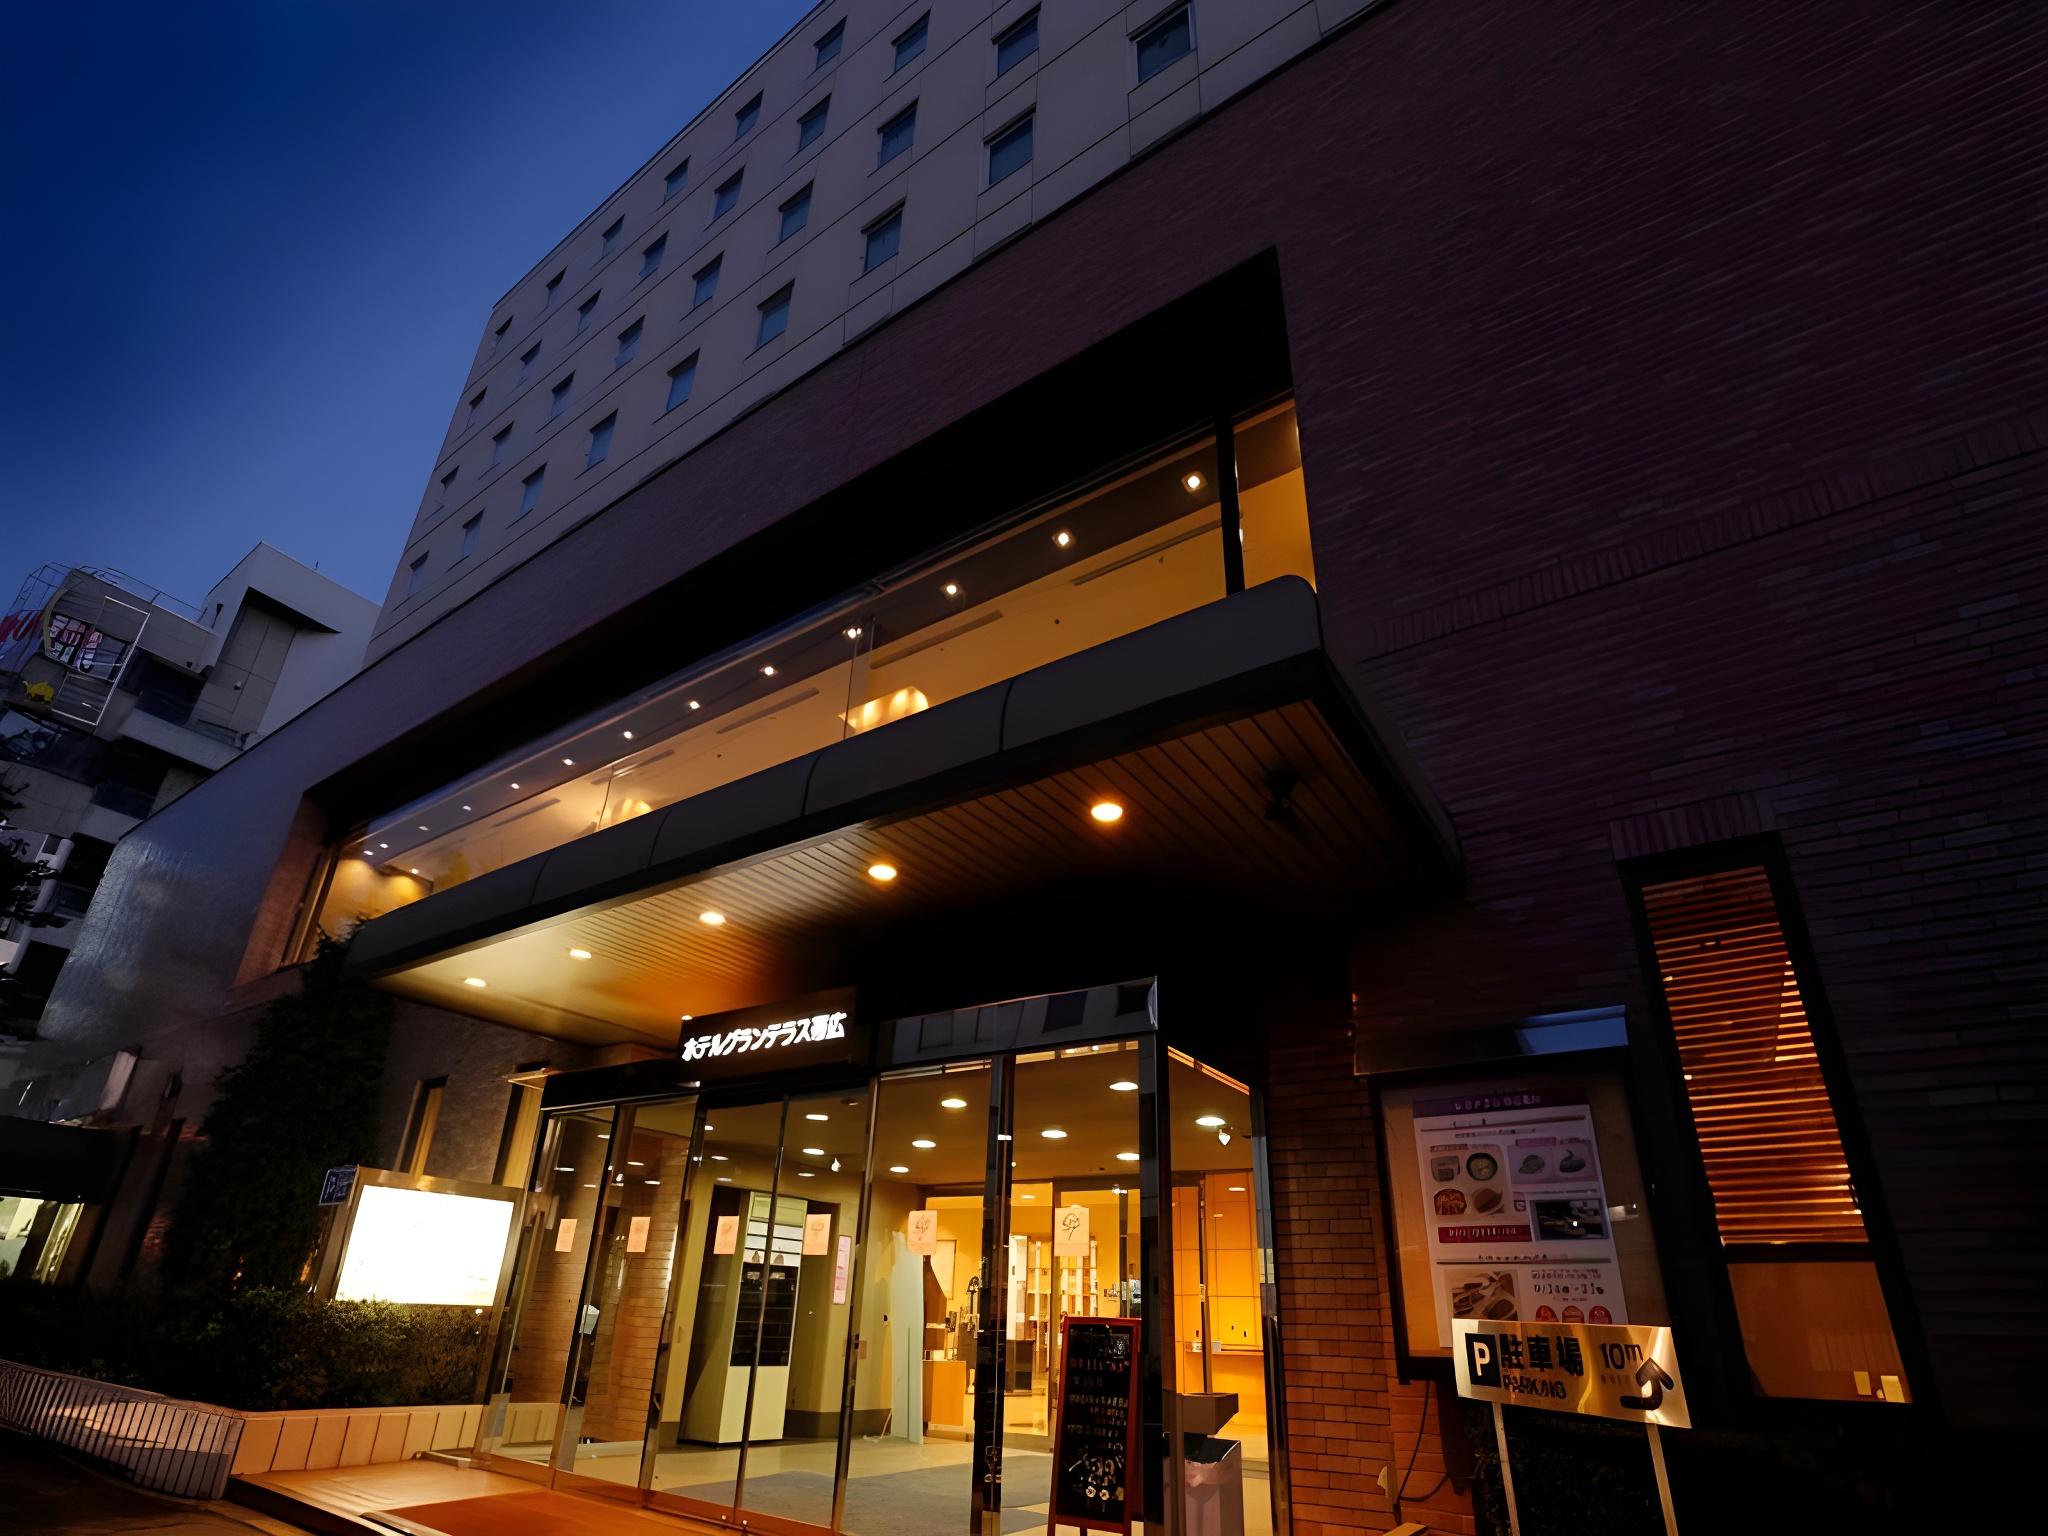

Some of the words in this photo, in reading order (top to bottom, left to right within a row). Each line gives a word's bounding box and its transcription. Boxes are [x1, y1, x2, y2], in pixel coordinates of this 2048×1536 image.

[1473, 1341, 1491, 1377] P
[1499, 1333, 1584, 1376] 駐車場
[1600, 1342, 1643, 1370] 10m
